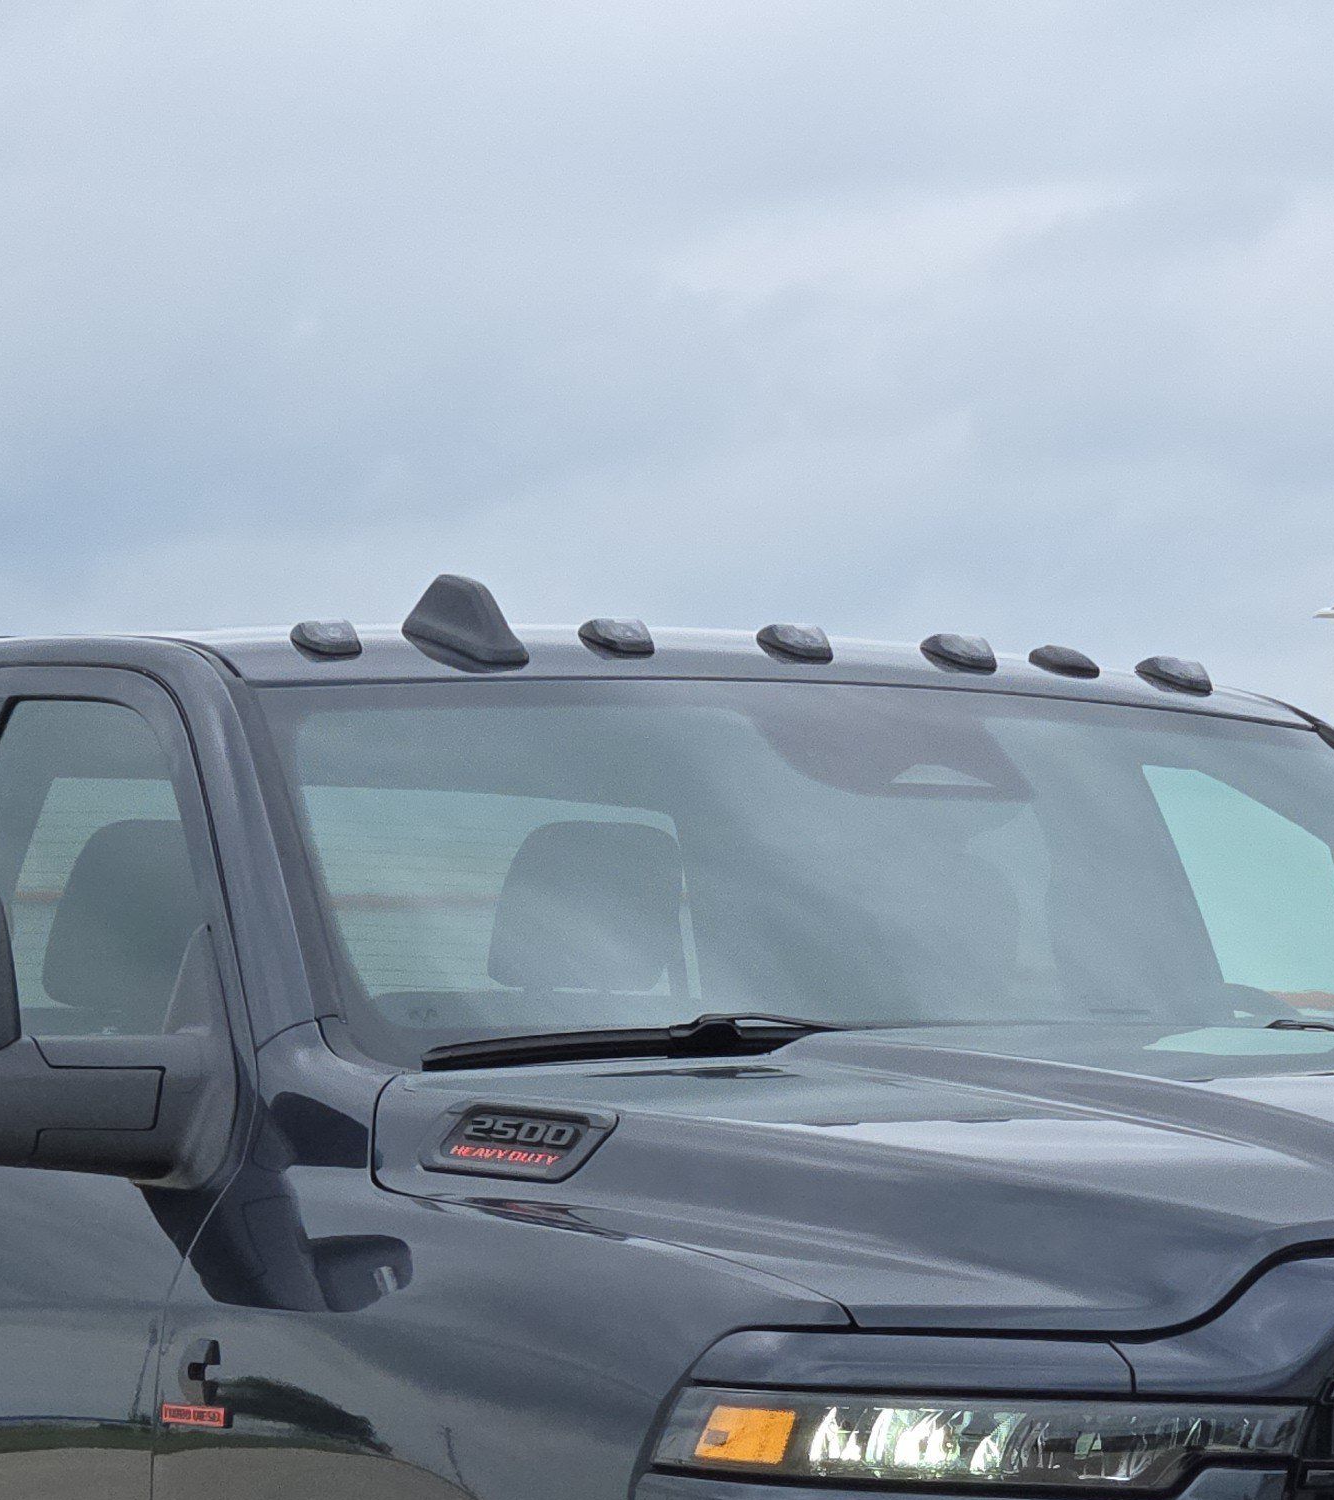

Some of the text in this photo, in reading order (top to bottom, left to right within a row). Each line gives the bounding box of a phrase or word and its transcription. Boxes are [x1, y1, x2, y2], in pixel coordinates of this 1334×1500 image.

[464, 1117, 577, 1147] 2500
[450, 1145, 560, 1166] HEAVY DUTY
